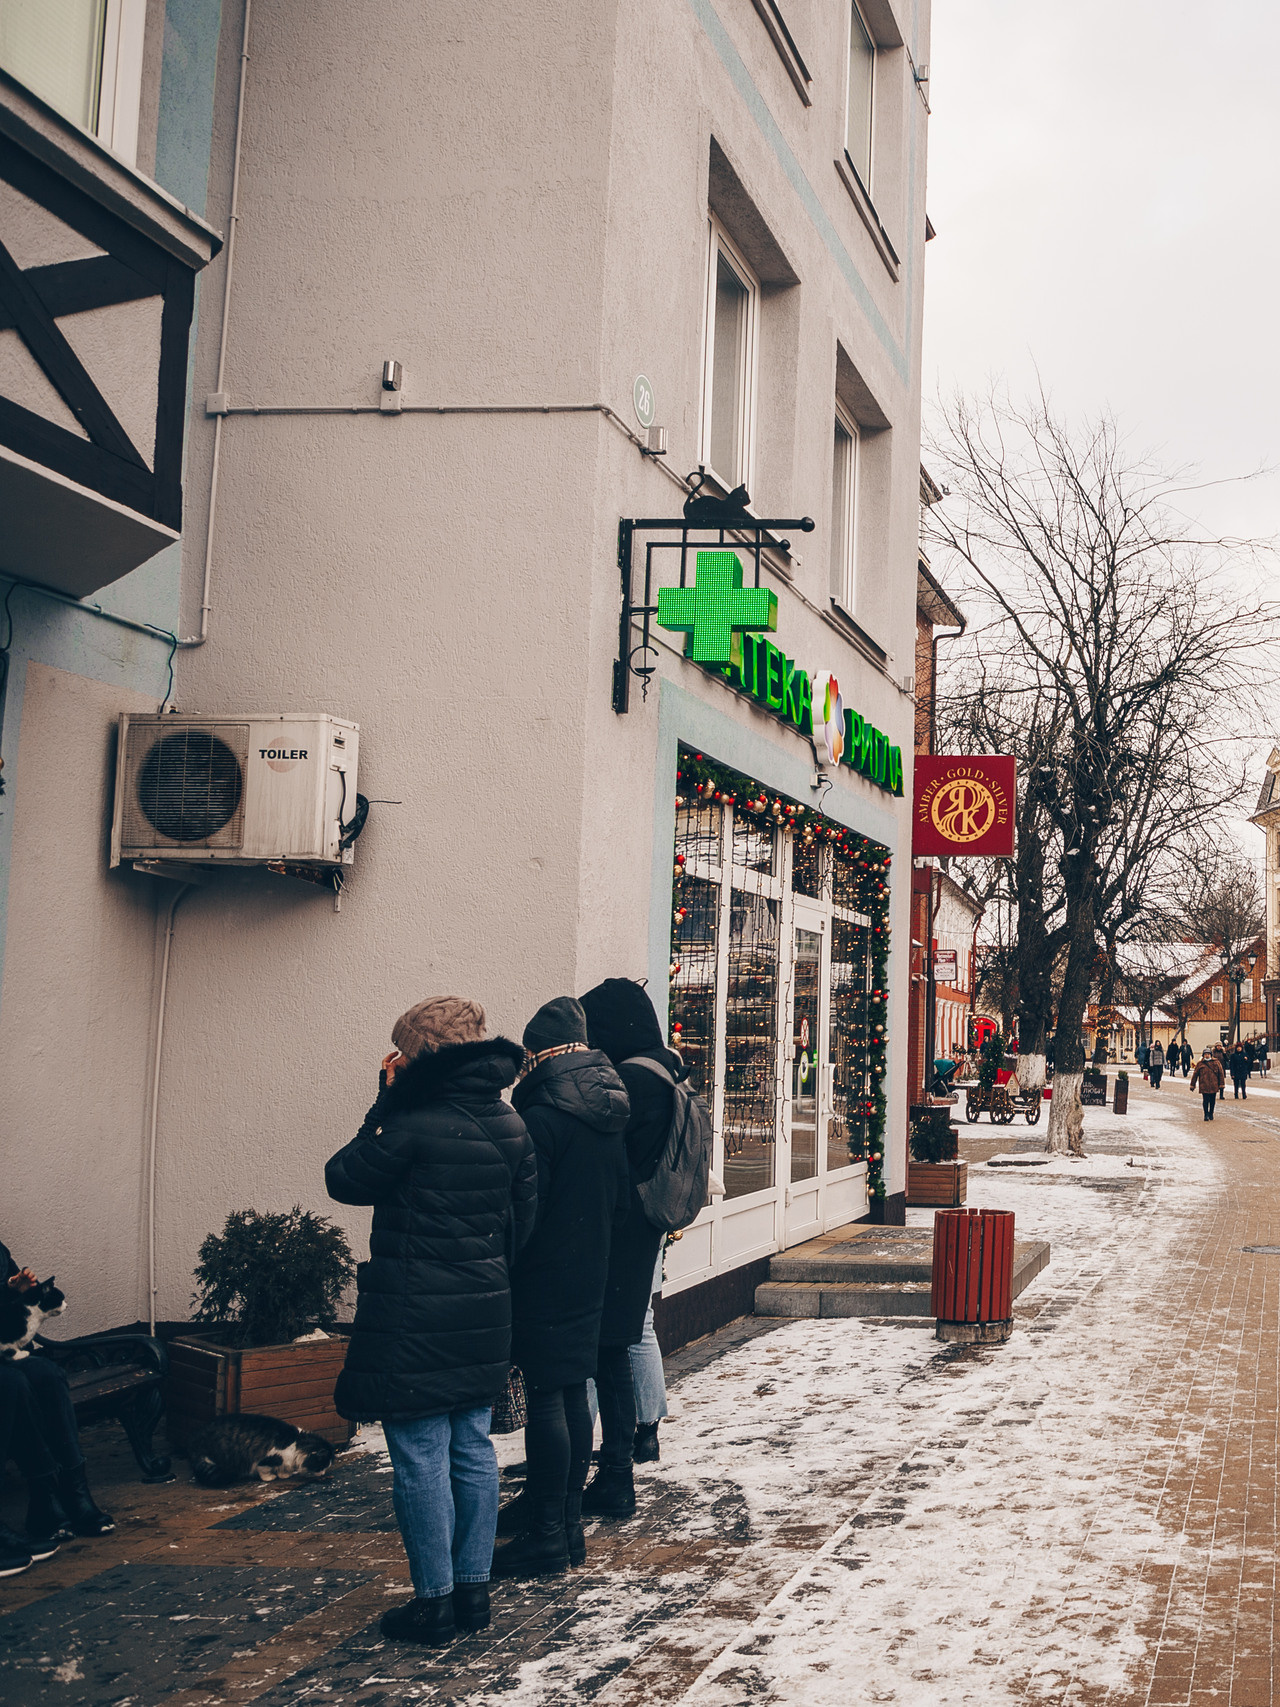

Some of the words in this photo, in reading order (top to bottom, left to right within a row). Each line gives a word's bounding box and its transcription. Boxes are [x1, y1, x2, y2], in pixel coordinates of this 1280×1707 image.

[638, 385, 650, 416] 26
[258, 748, 309, 760] TOILER
[844, 707, 905, 797] РИГЛА
[918, 779, 942, 823] AMBER
[946, 767, 984, 780] GOLD
[988, 780, 1009, 825] SILVER
